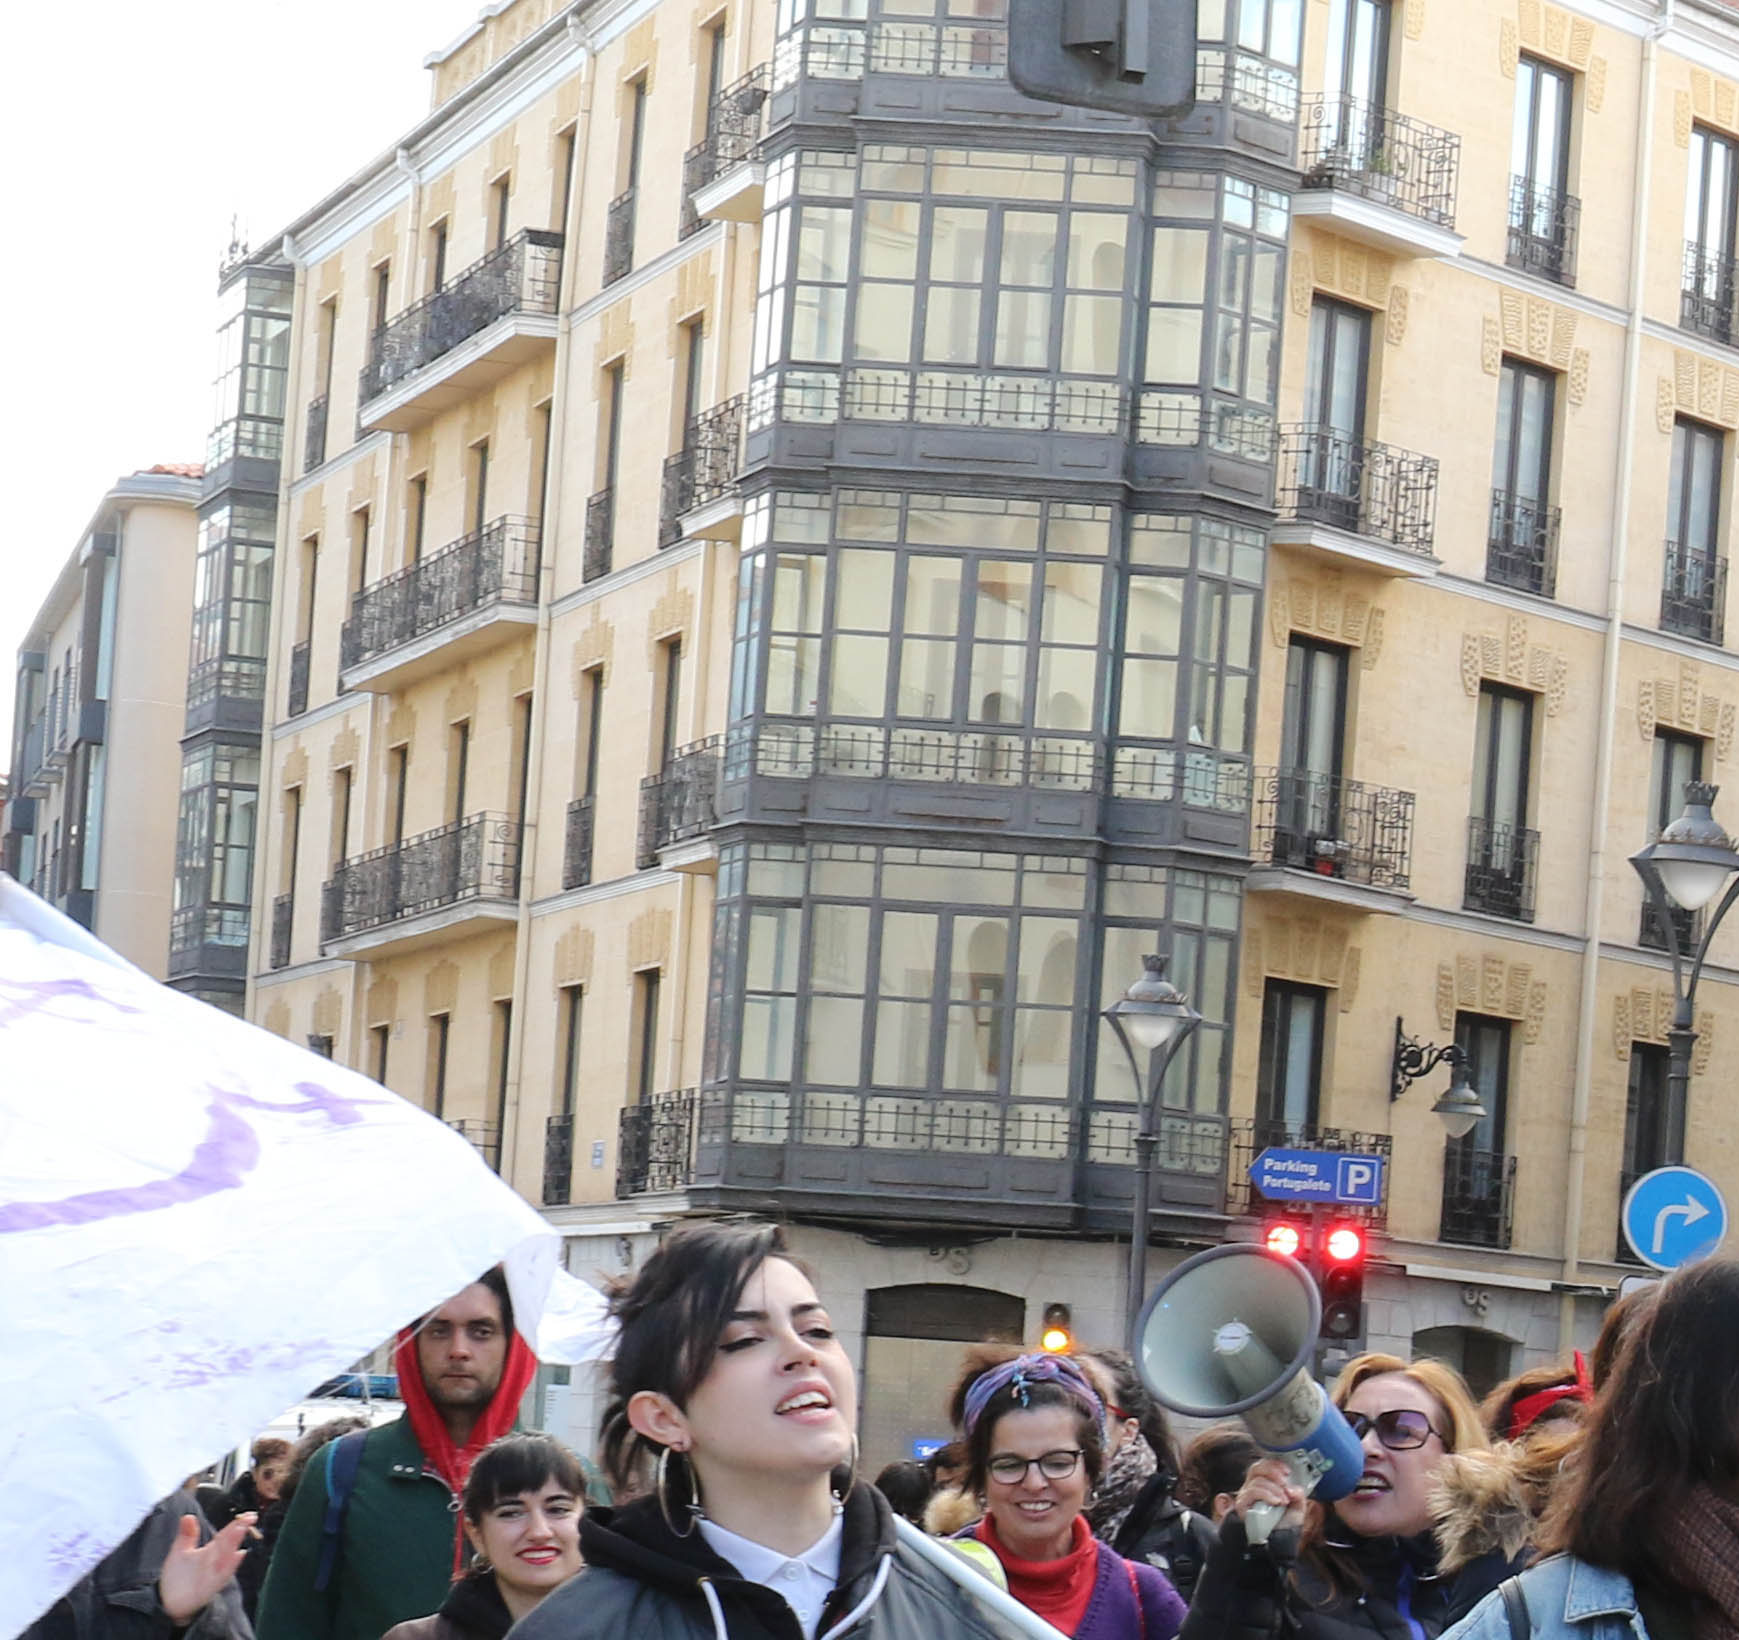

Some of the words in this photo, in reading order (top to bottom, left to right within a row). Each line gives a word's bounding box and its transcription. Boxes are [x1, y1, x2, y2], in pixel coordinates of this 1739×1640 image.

[1264, 1158, 1319, 1176] Parking
[1263, 1175, 1332, 1192] Portugalete
[1346, 1164, 1371, 1195] P
